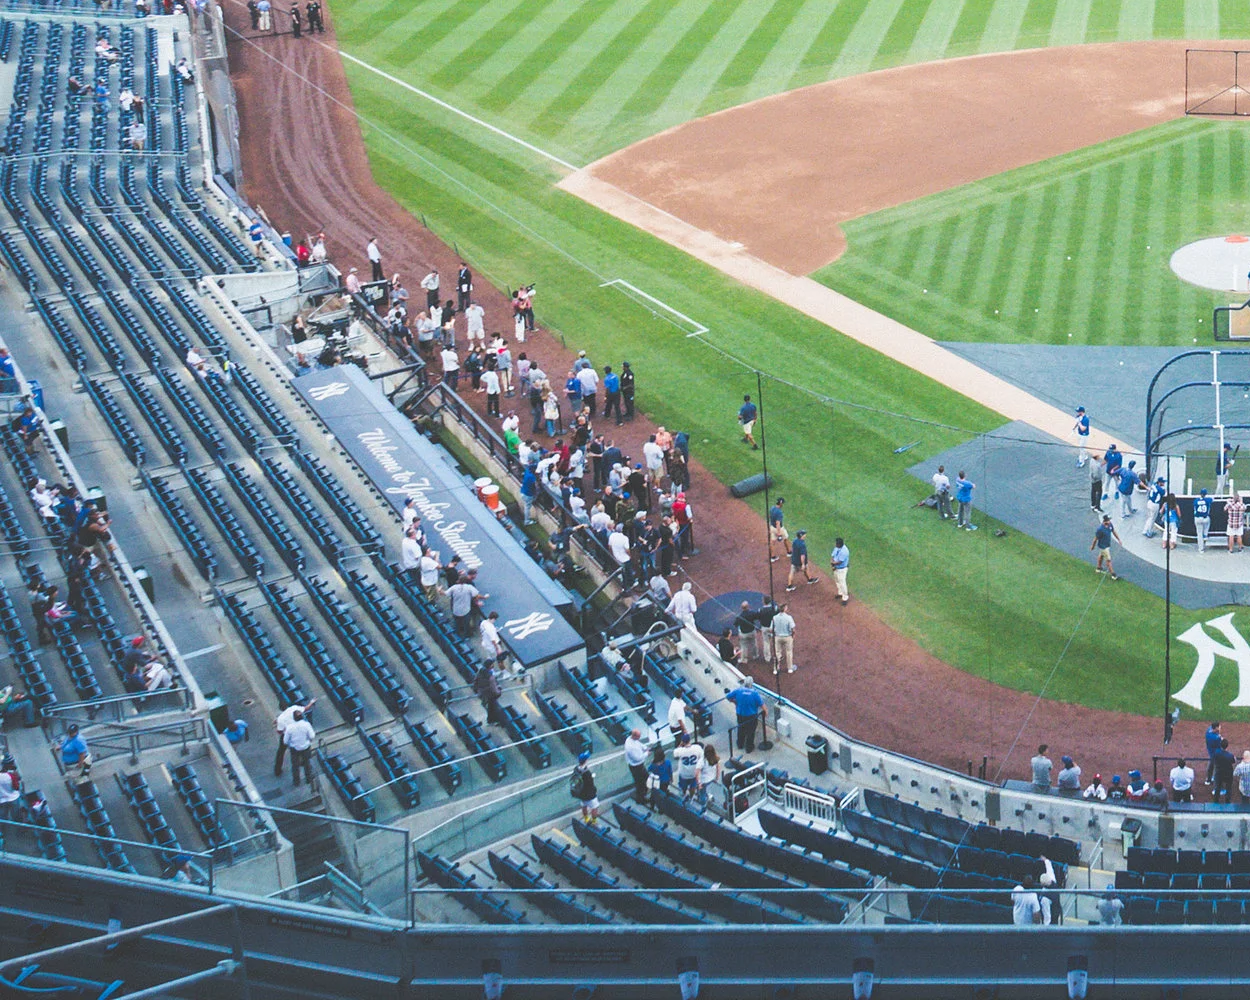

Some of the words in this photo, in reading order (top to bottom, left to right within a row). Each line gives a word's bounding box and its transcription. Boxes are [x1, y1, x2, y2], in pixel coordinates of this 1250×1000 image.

[391, 467, 415, 482] to
[434, 520, 484, 570] Stadium
[1196, 503, 1208, 514] 49
